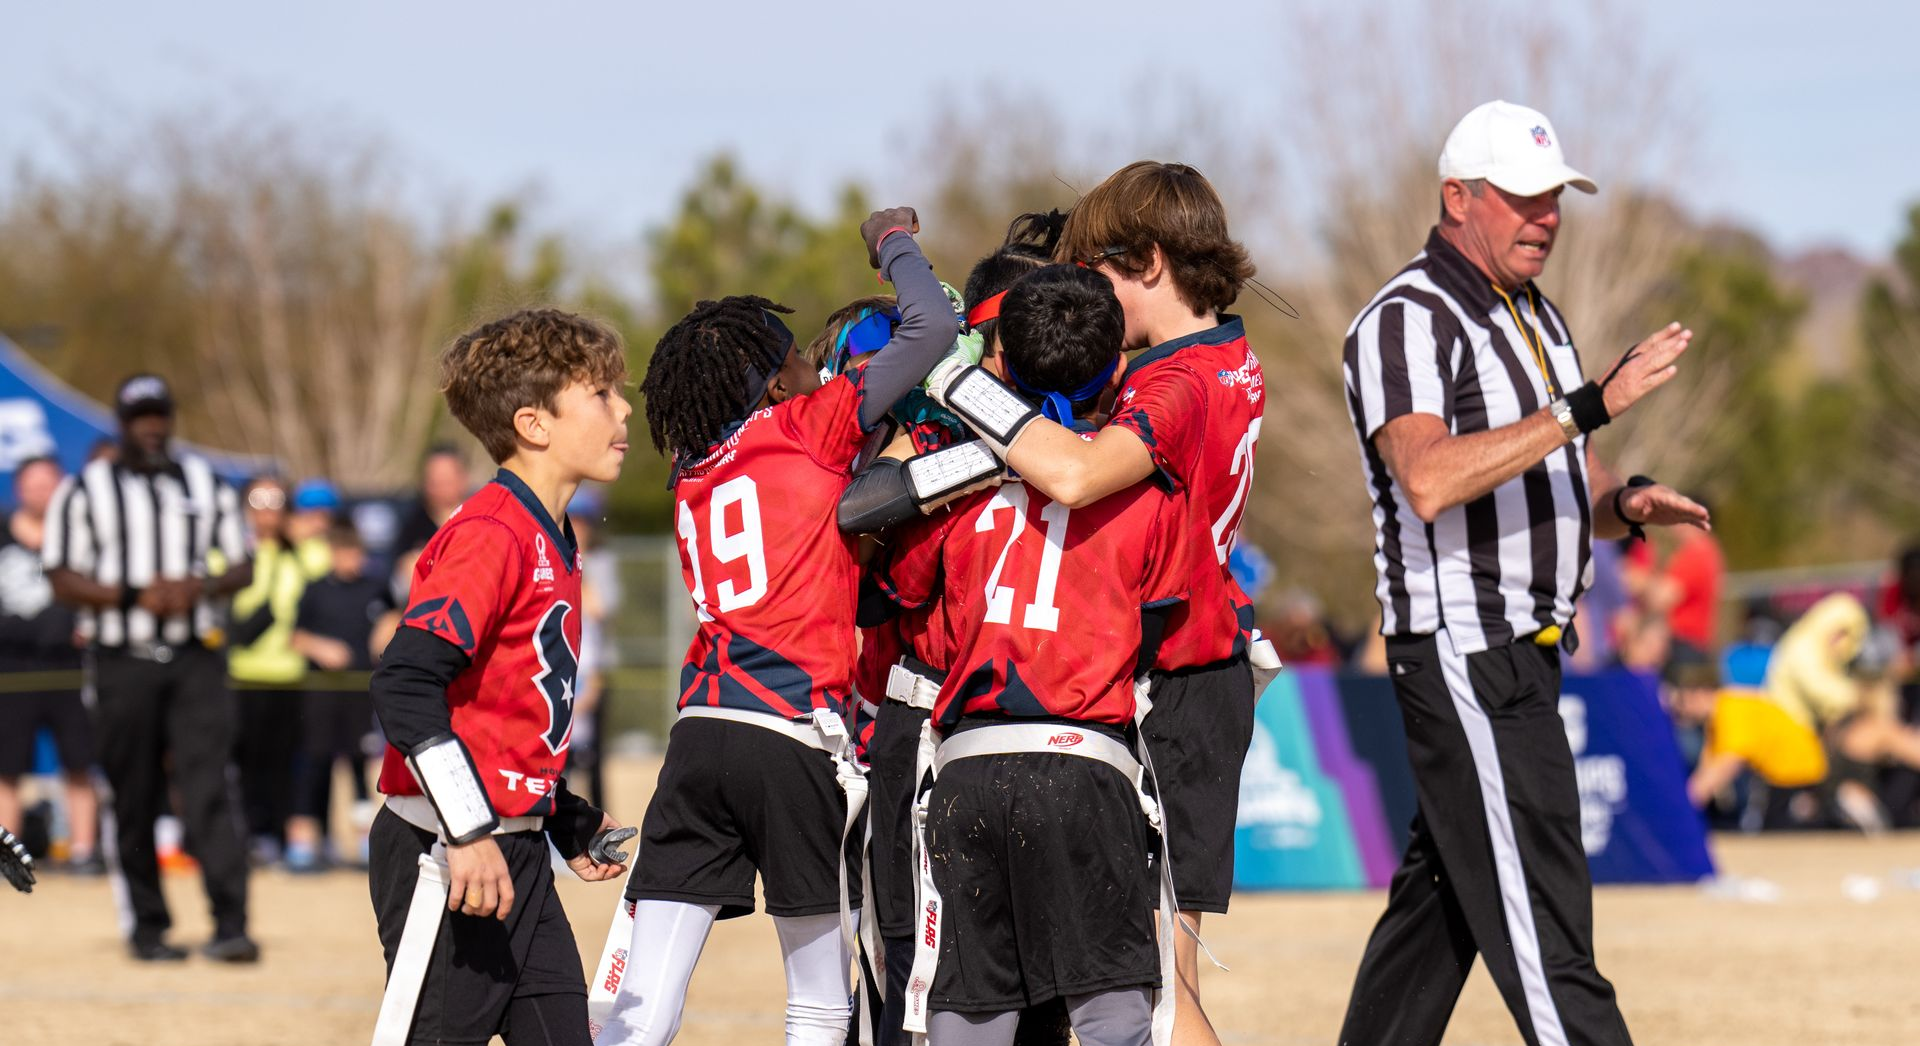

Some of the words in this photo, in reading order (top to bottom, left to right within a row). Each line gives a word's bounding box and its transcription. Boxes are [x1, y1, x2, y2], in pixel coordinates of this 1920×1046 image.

[678, 474, 768, 623] 19
[975, 481, 1071, 633] 21
[1047, 733, 1083, 746] NERF
[925, 908, 937, 949] FLAG
[604, 954, 626, 995] FLAG
